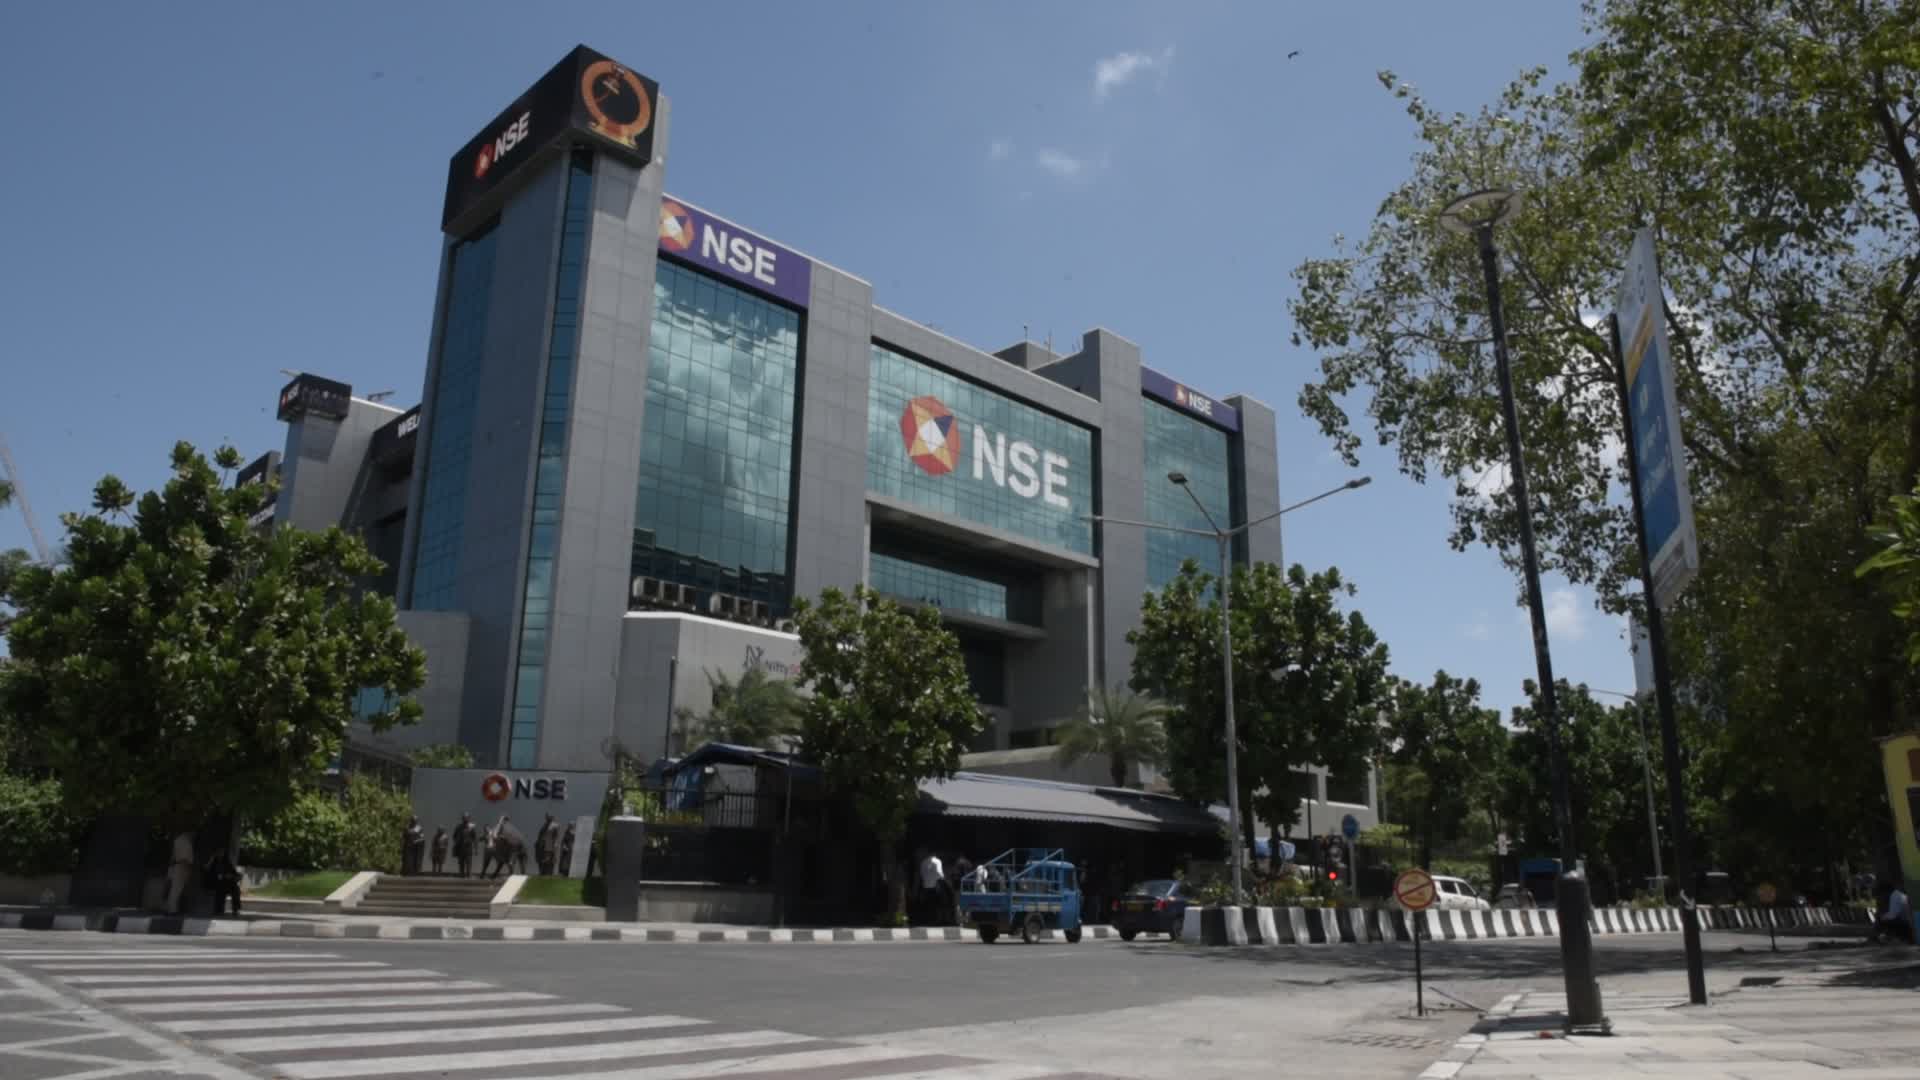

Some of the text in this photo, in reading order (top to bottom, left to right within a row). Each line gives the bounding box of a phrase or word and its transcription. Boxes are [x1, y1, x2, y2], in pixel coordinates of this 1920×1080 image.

[494, 112, 529, 162] NSE
[702, 226, 776, 286] NSE
[1189, 393, 1212, 416] NSE
[973, 426, 1069, 506] NSE
[515, 779, 565, 799] NSE
